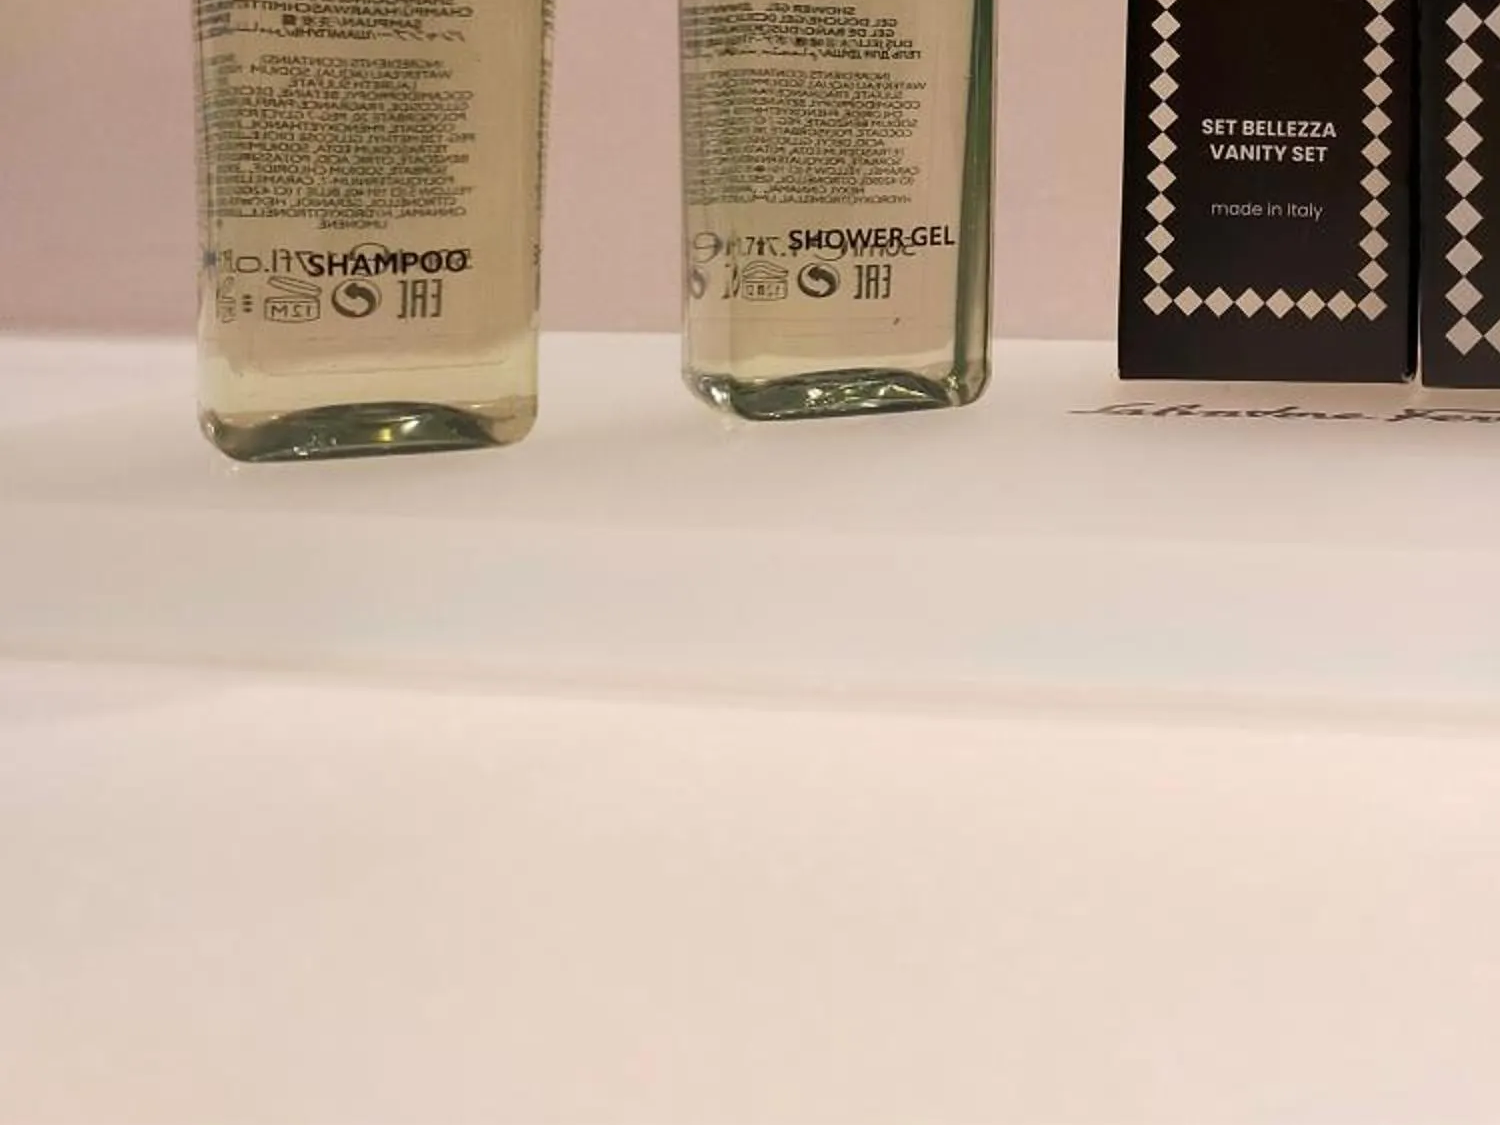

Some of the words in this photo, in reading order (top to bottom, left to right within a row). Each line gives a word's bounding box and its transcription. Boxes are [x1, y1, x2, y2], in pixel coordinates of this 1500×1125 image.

[1202, 118, 1237, 135] SET
[1242, 120, 1337, 138] BELLEZZA
[1210, 144, 1287, 161] VANITY
[1292, 146, 1328, 162] SET
[1211, 203, 1262, 216] made
[1267, 203, 1282, 216] in
[1287, 203, 1323, 222] Italy
[789, 227, 911, 251] SHOWER
[912, 225, 954, 246] GEL
[306, 249, 467, 276] SHAMPOO
